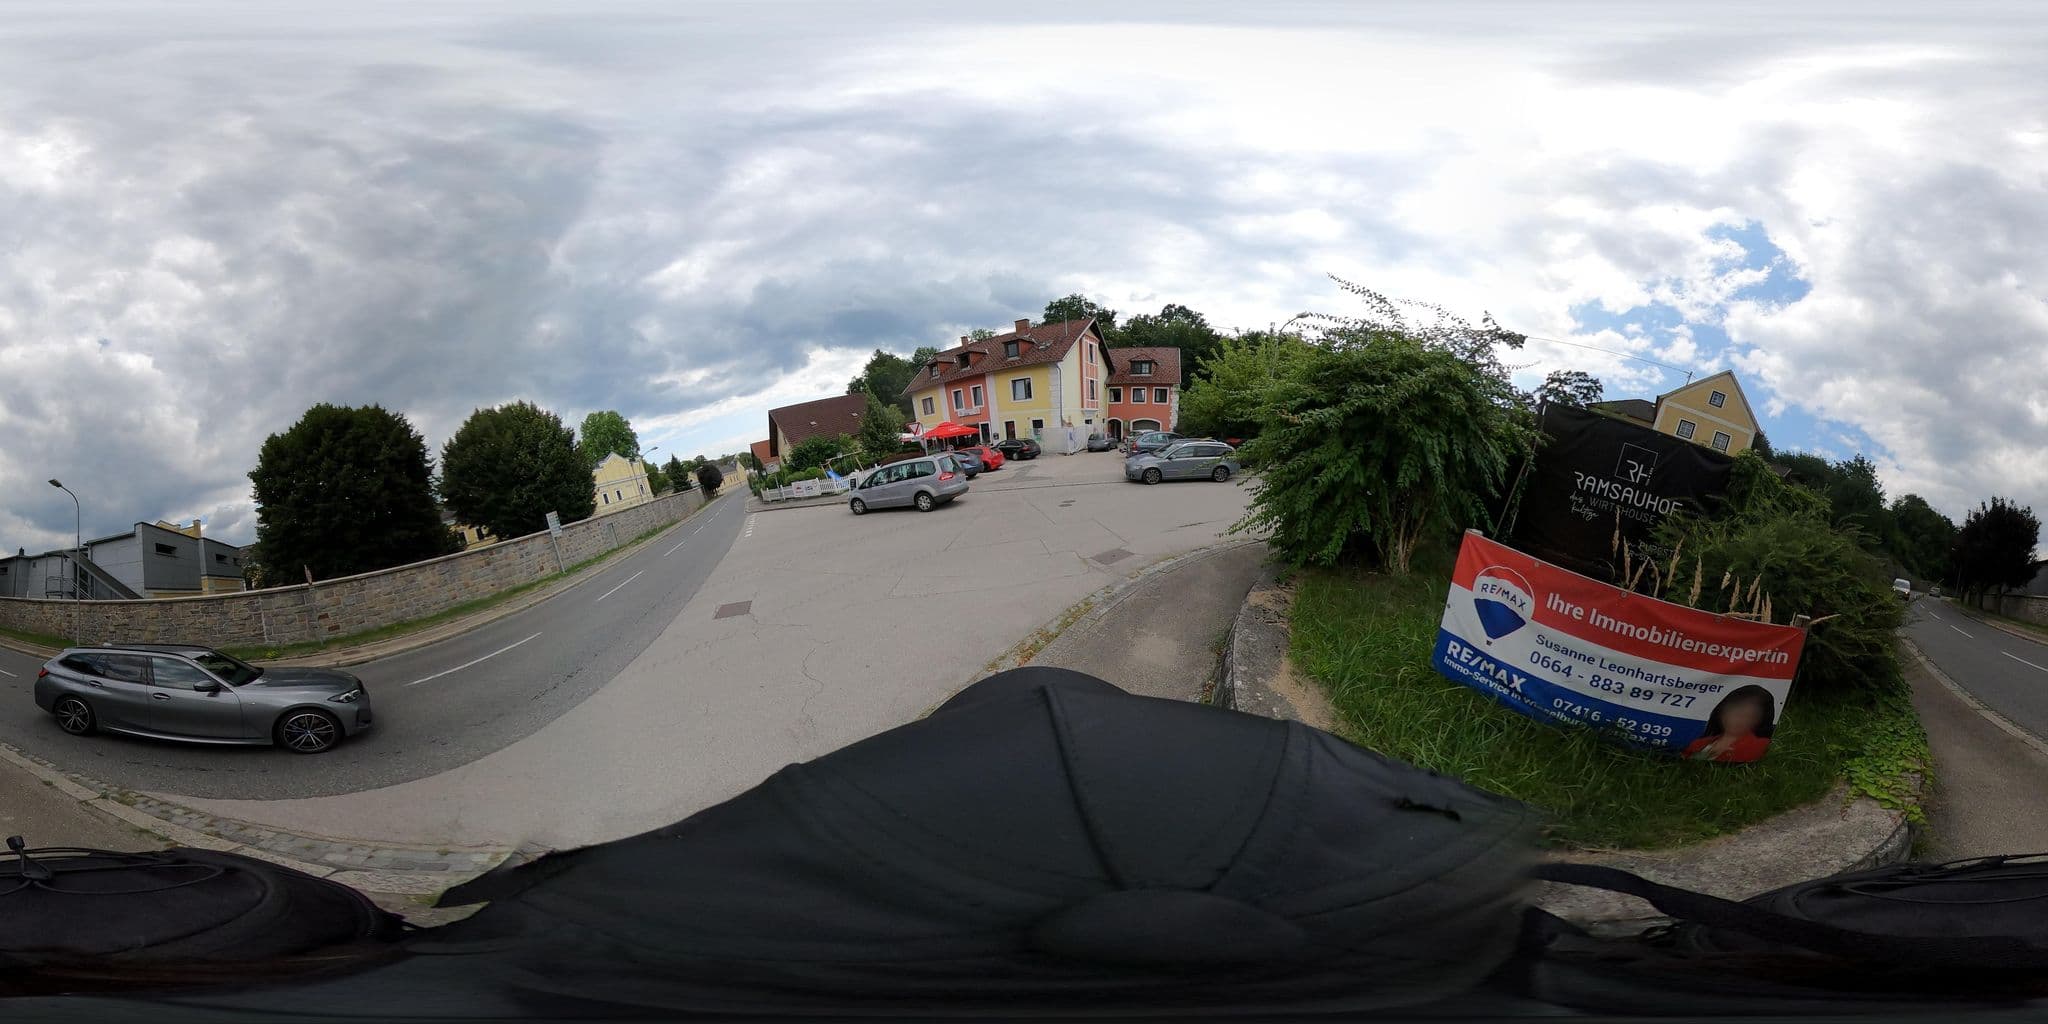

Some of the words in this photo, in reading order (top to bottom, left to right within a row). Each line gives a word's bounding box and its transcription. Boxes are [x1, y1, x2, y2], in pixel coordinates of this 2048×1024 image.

[1574, 471, 1683, 516] RAMSAUHOF
[1480, 583, 1526, 612] RE/MAX
[1546, 592, 1585, 620] Ihre
[1589, 608, 1789, 664] Immobilienexpertin
[1443, 655, 1510, 695] Immo-Service
[1510, 690, 1522, 702] in
[1447, 640, 1527, 693] RE/MAX
[1530, 651, 1573, 678] 0664
[1589, 674, 1625, 695] 883
[1629, 687, 1654, 701] 89
[1660, 692, 1697, 709] 727
[1535, 634, 1596, 665] Susanne
[1599, 657, 1724, 695] Leonhartsberger
[1553, 698, 1601, 722] 07416
[1616, 717, 1637, 731] 52
[1641, 722, 1673, 737] 939
